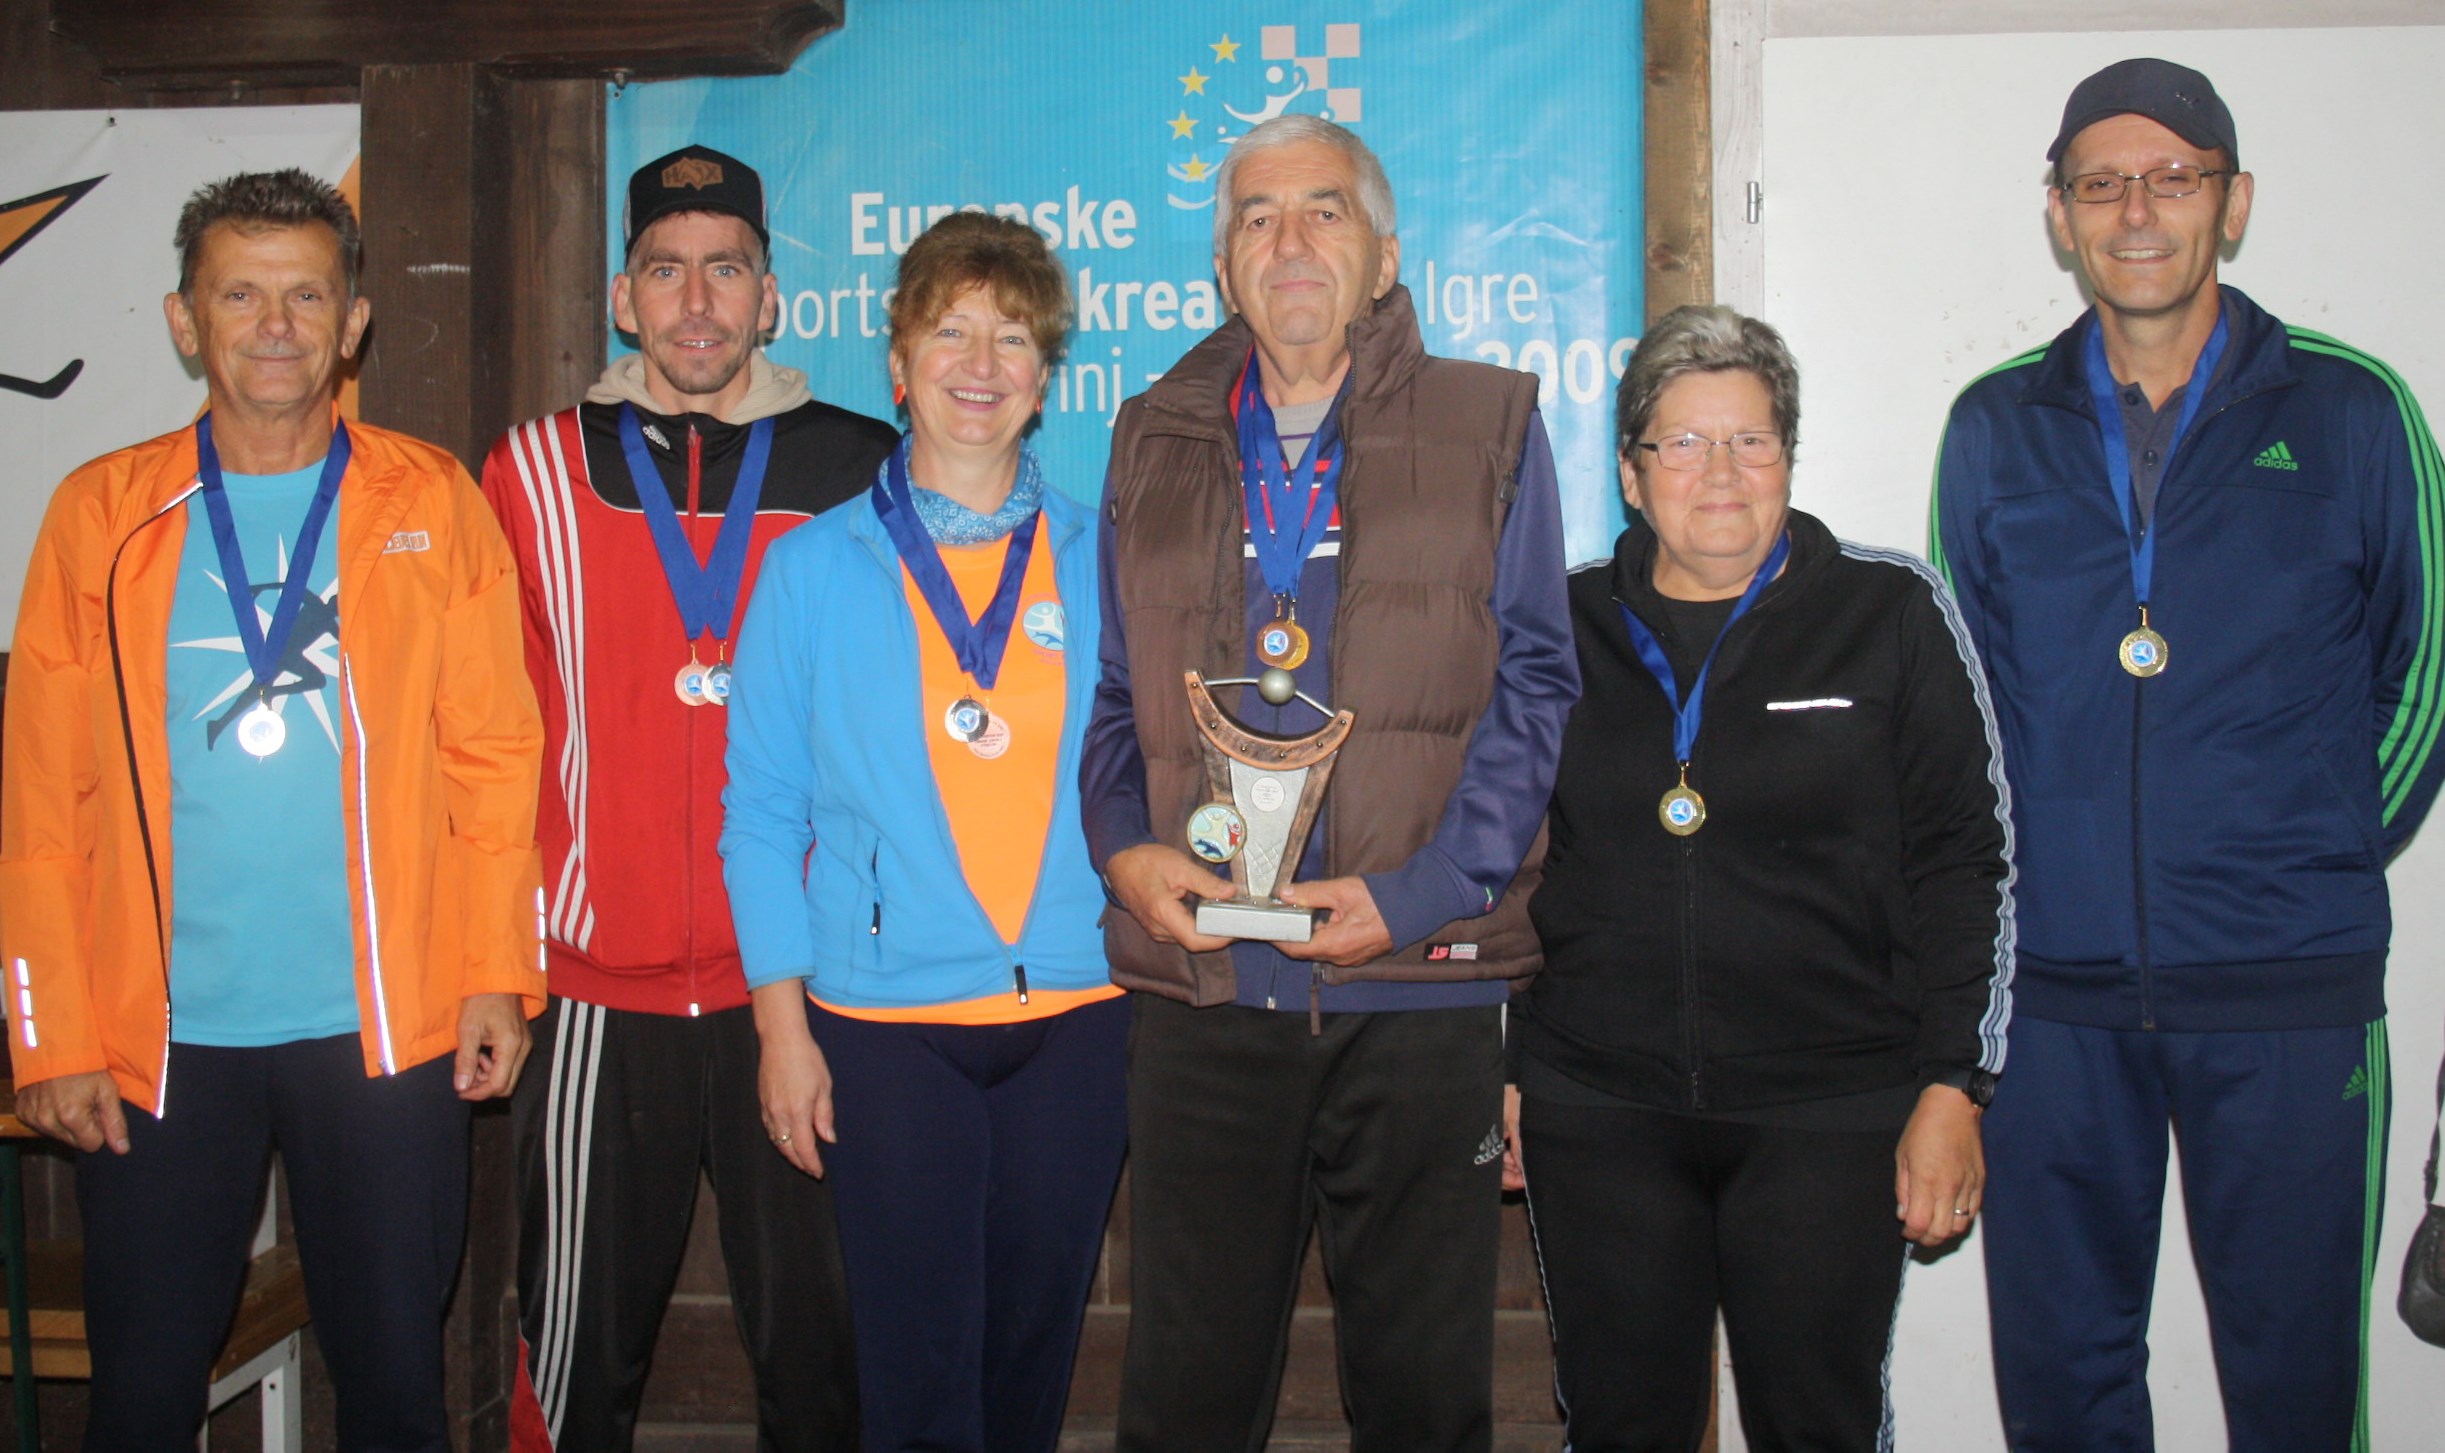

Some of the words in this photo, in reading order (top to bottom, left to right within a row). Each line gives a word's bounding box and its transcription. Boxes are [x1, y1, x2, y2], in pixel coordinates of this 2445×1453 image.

[851, 184, 1137, 256] Eurske
[1426, 260, 1540, 341] Igre
[2253, 456, 2299, 472] adidas
